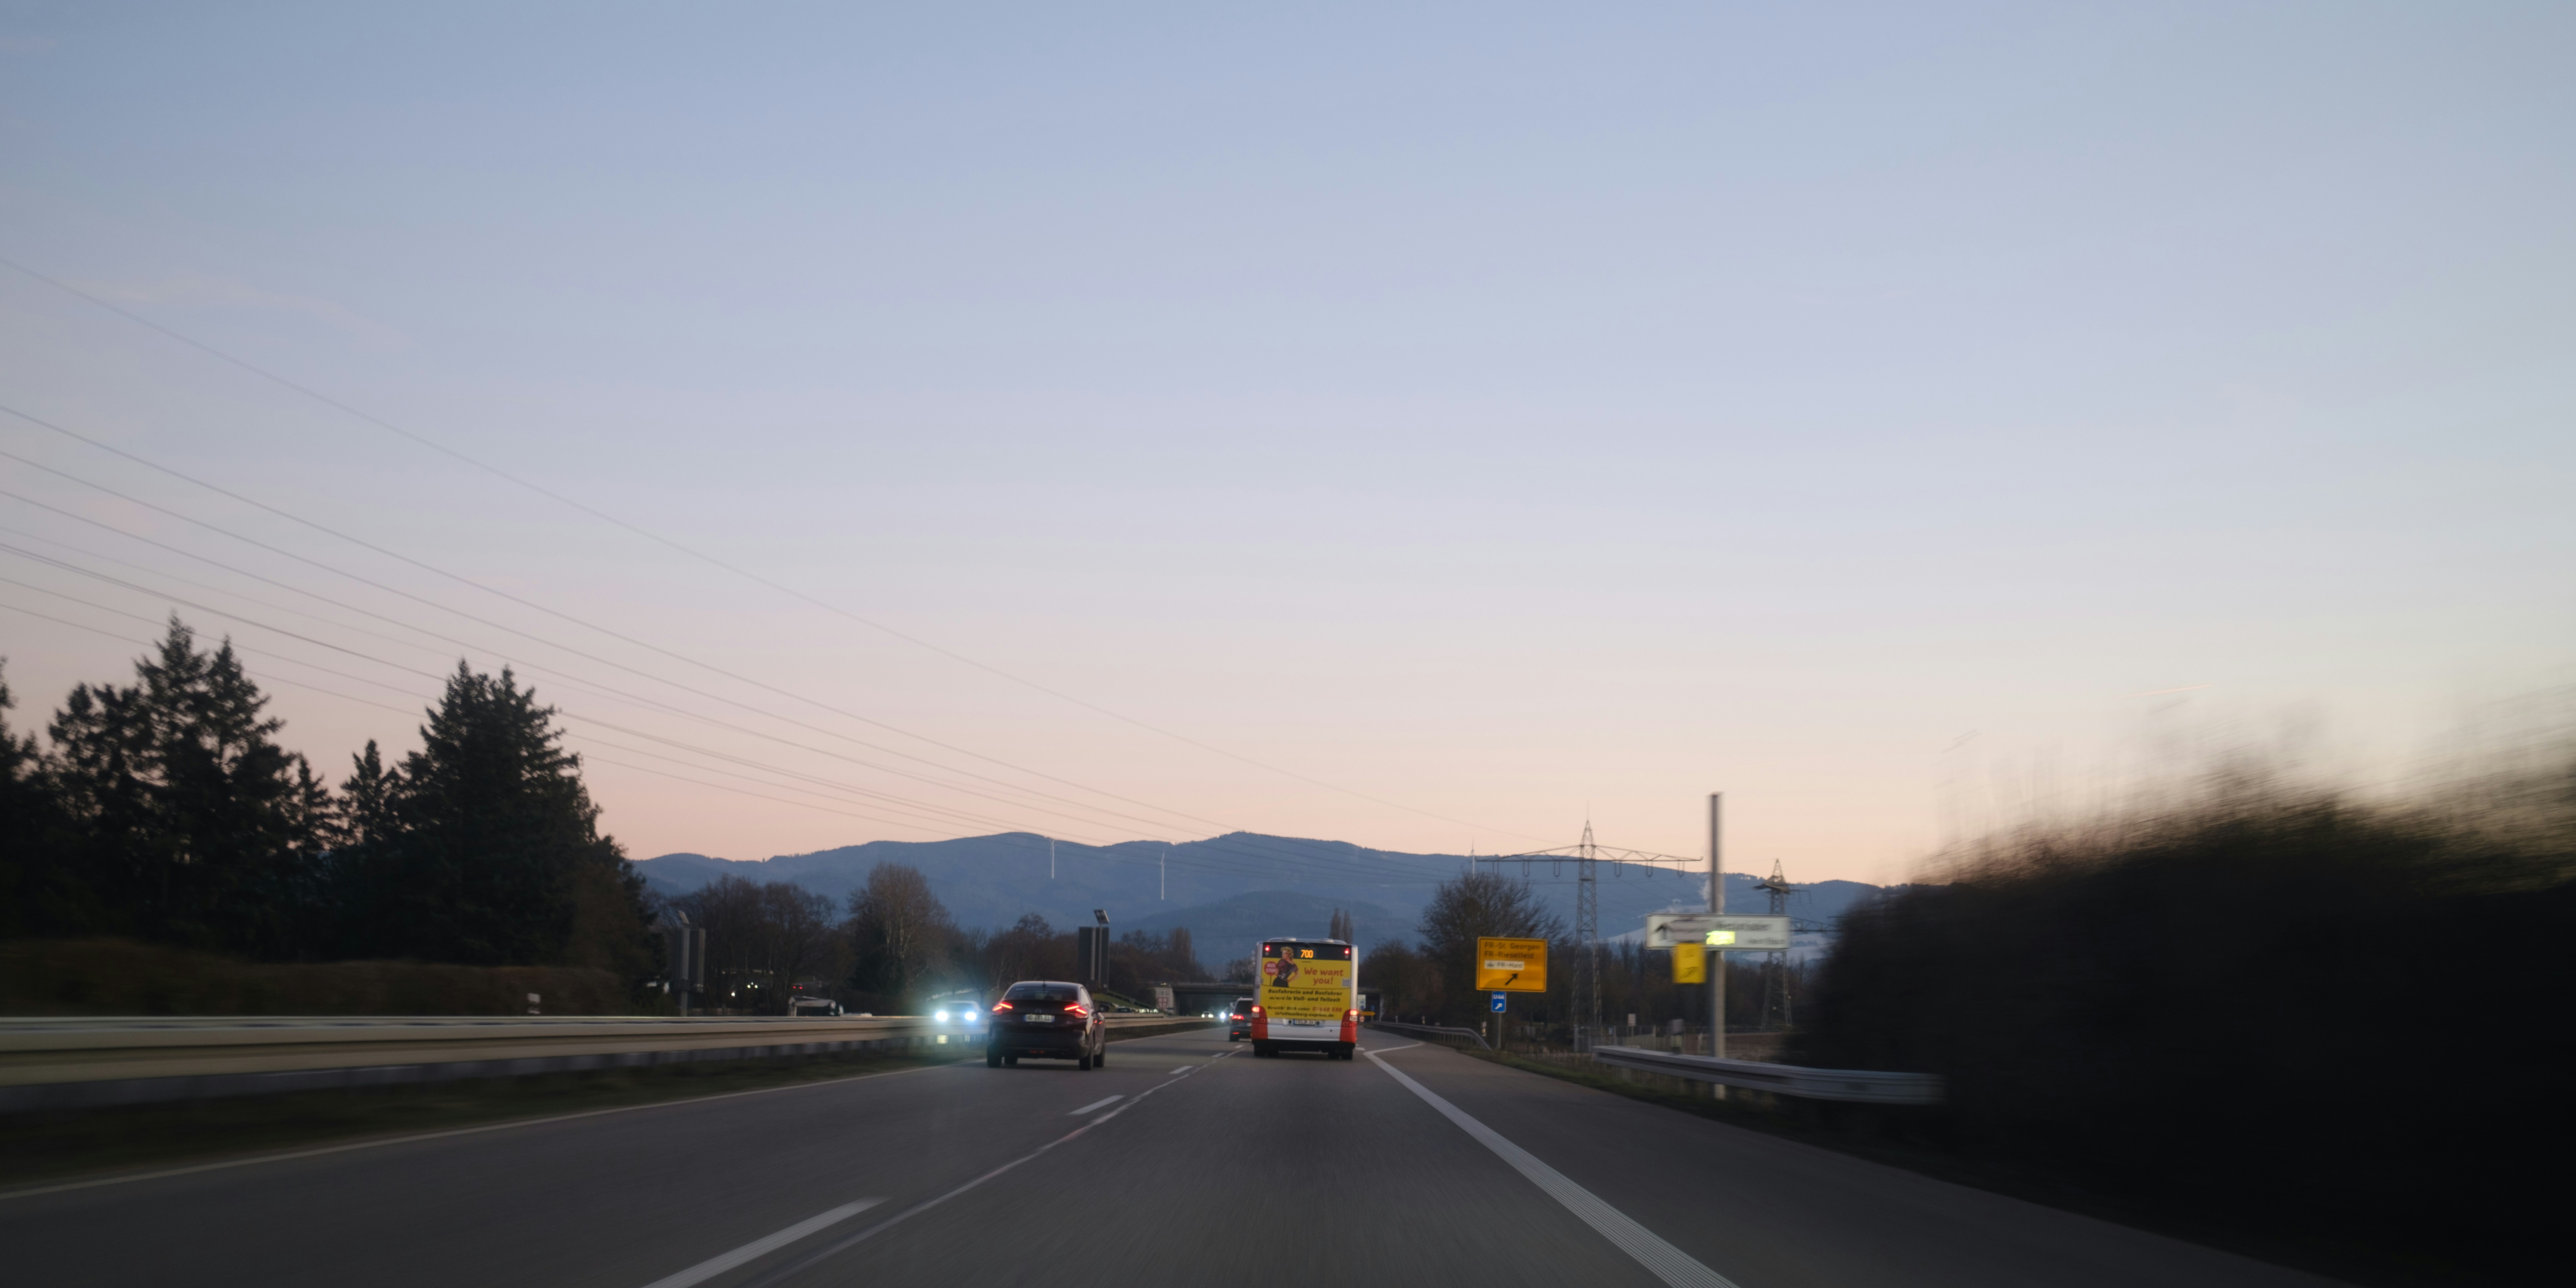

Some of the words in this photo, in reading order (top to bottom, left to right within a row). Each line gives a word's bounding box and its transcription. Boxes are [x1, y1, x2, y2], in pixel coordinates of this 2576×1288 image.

[1510, 943, 1540, 951] Georgen
[1300, 949, 1313, 958] 700
[1484, 951, 1534, 959] FR-Rieselfeld
[1304, 967, 1317, 975] We
[1313, 977, 1333, 985] you!
